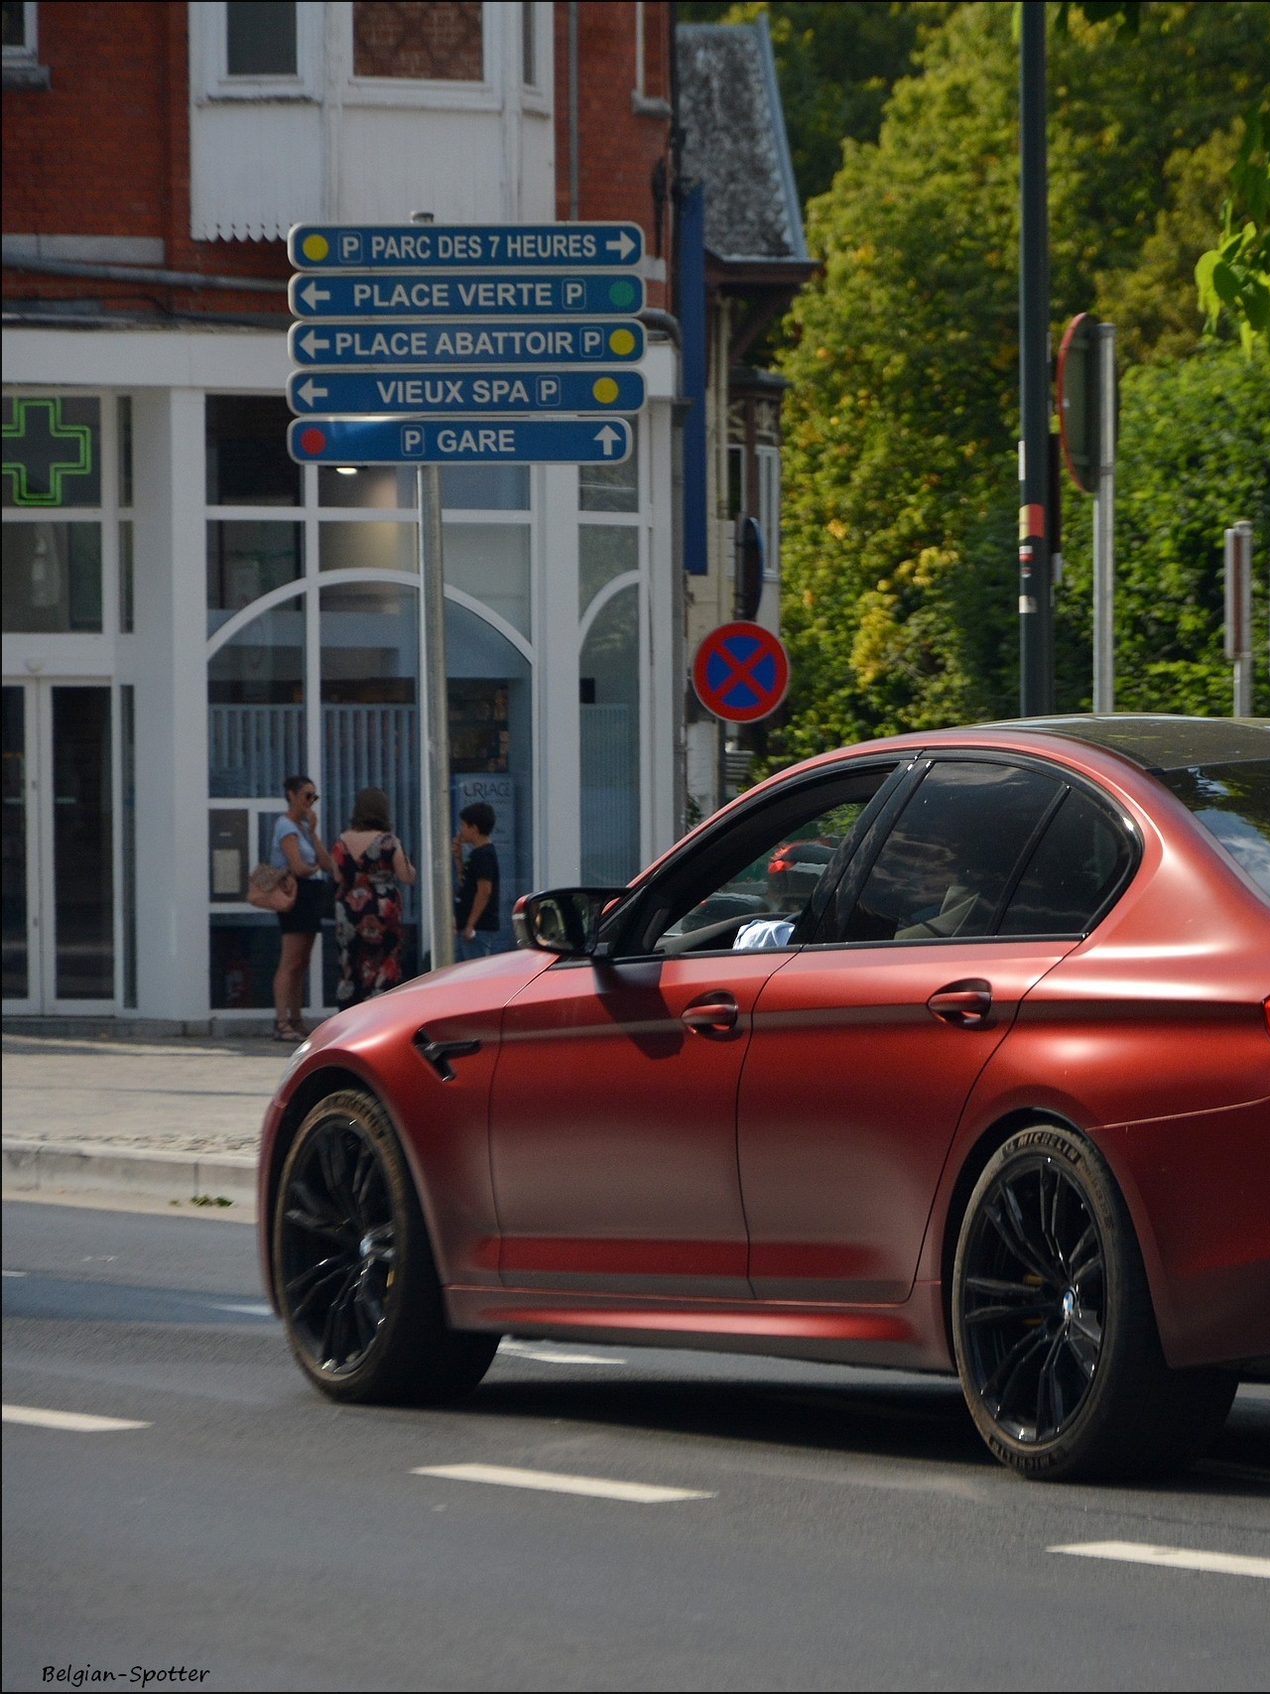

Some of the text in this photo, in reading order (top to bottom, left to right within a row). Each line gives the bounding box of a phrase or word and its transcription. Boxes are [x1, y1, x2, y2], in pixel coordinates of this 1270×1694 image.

[343, 235, 597, 258] P PARC DES 7 HEURES
[354, 283, 583, 306] PLACE VERTE P
[336, 331, 601, 355] PLACE ABATTOIR P
[377, 380, 557, 403] VIEUX SPA P
[405, 429, 516, 452] P GARE
[1018, 1132, 1080, 1163] MICHELIN
